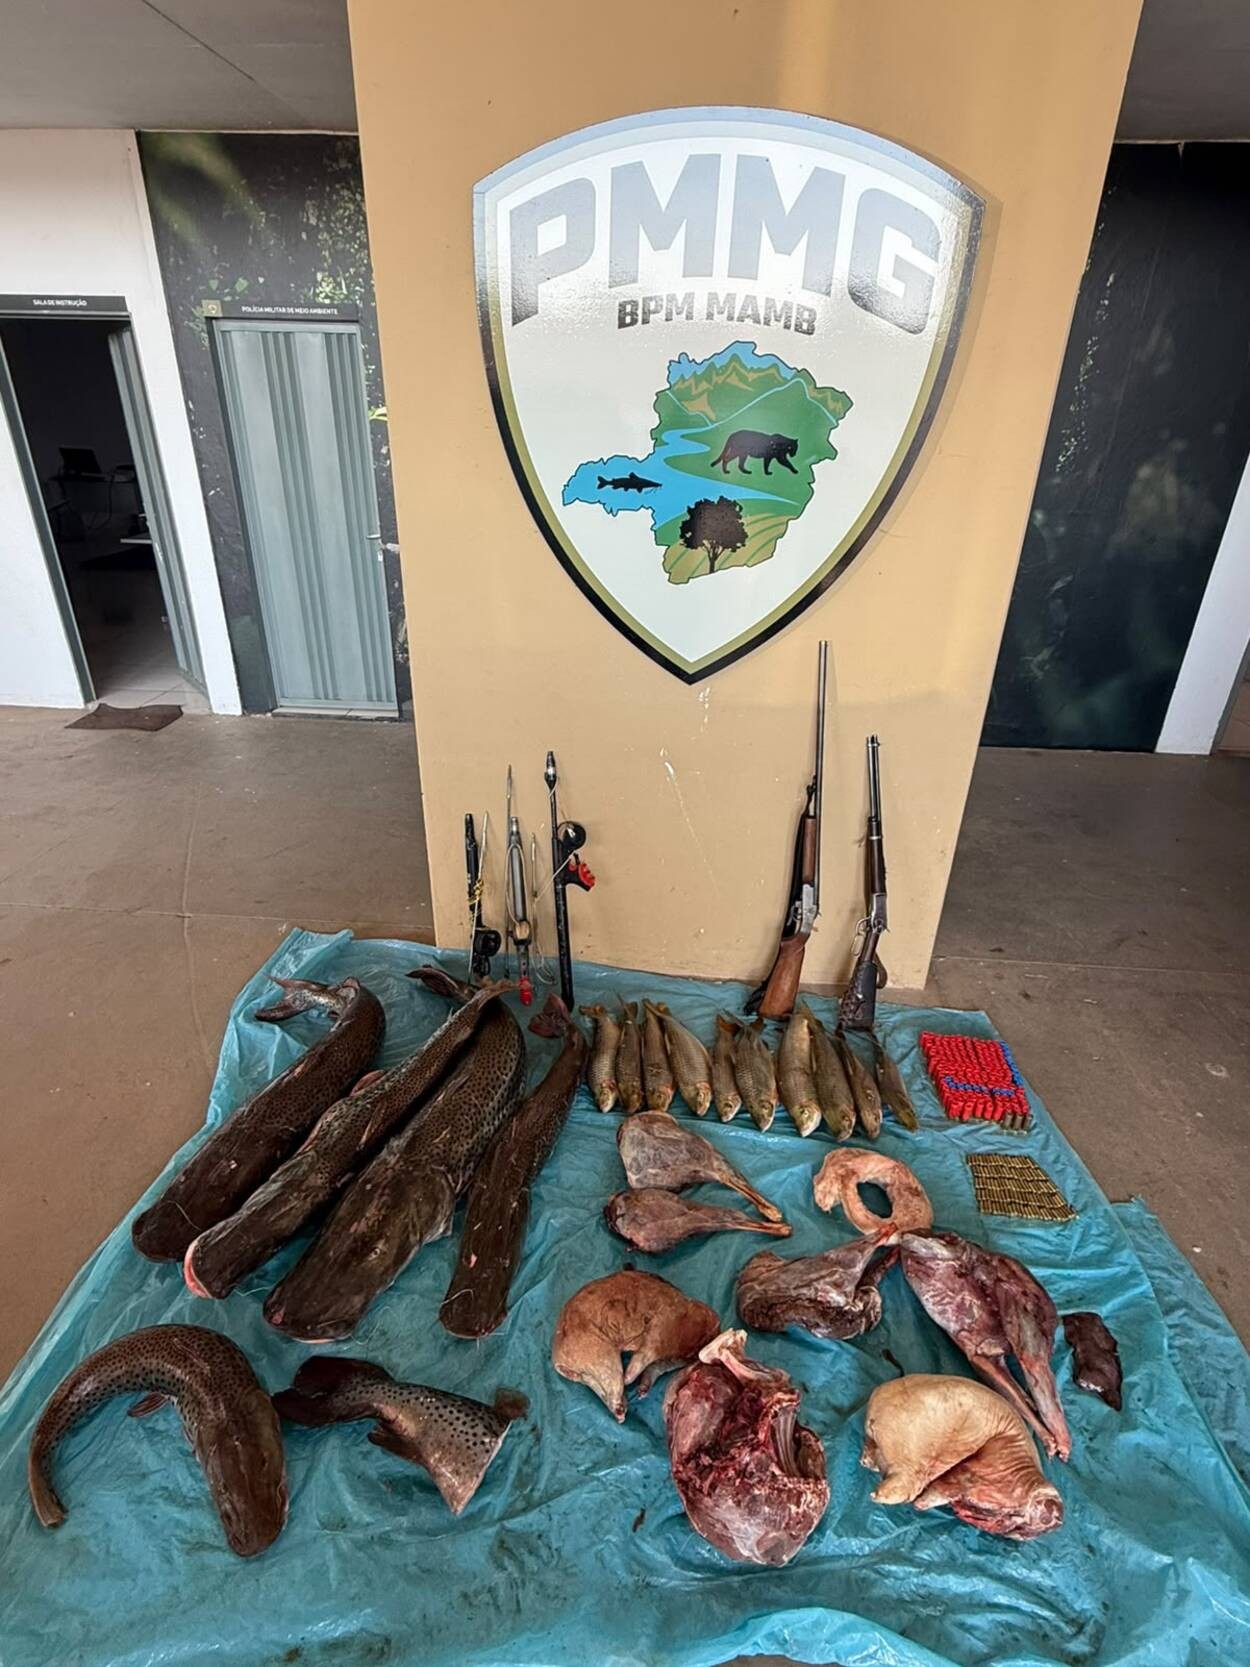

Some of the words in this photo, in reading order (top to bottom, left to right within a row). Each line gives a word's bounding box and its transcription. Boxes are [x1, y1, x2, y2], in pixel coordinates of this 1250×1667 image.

[509, 153, 942, 335] PMMG
[241, 304, 263, 313] POLÍCIA
[264, 305, 286, 313] MILITAR
[286, 306, 294, 314] DE
[294, 306, 309, 314] MEIO
[309, 307, 338, 315] AMBIENTE
[617, 292, 694, 329] BPM
[705, 292, 818, 336] MAMB
